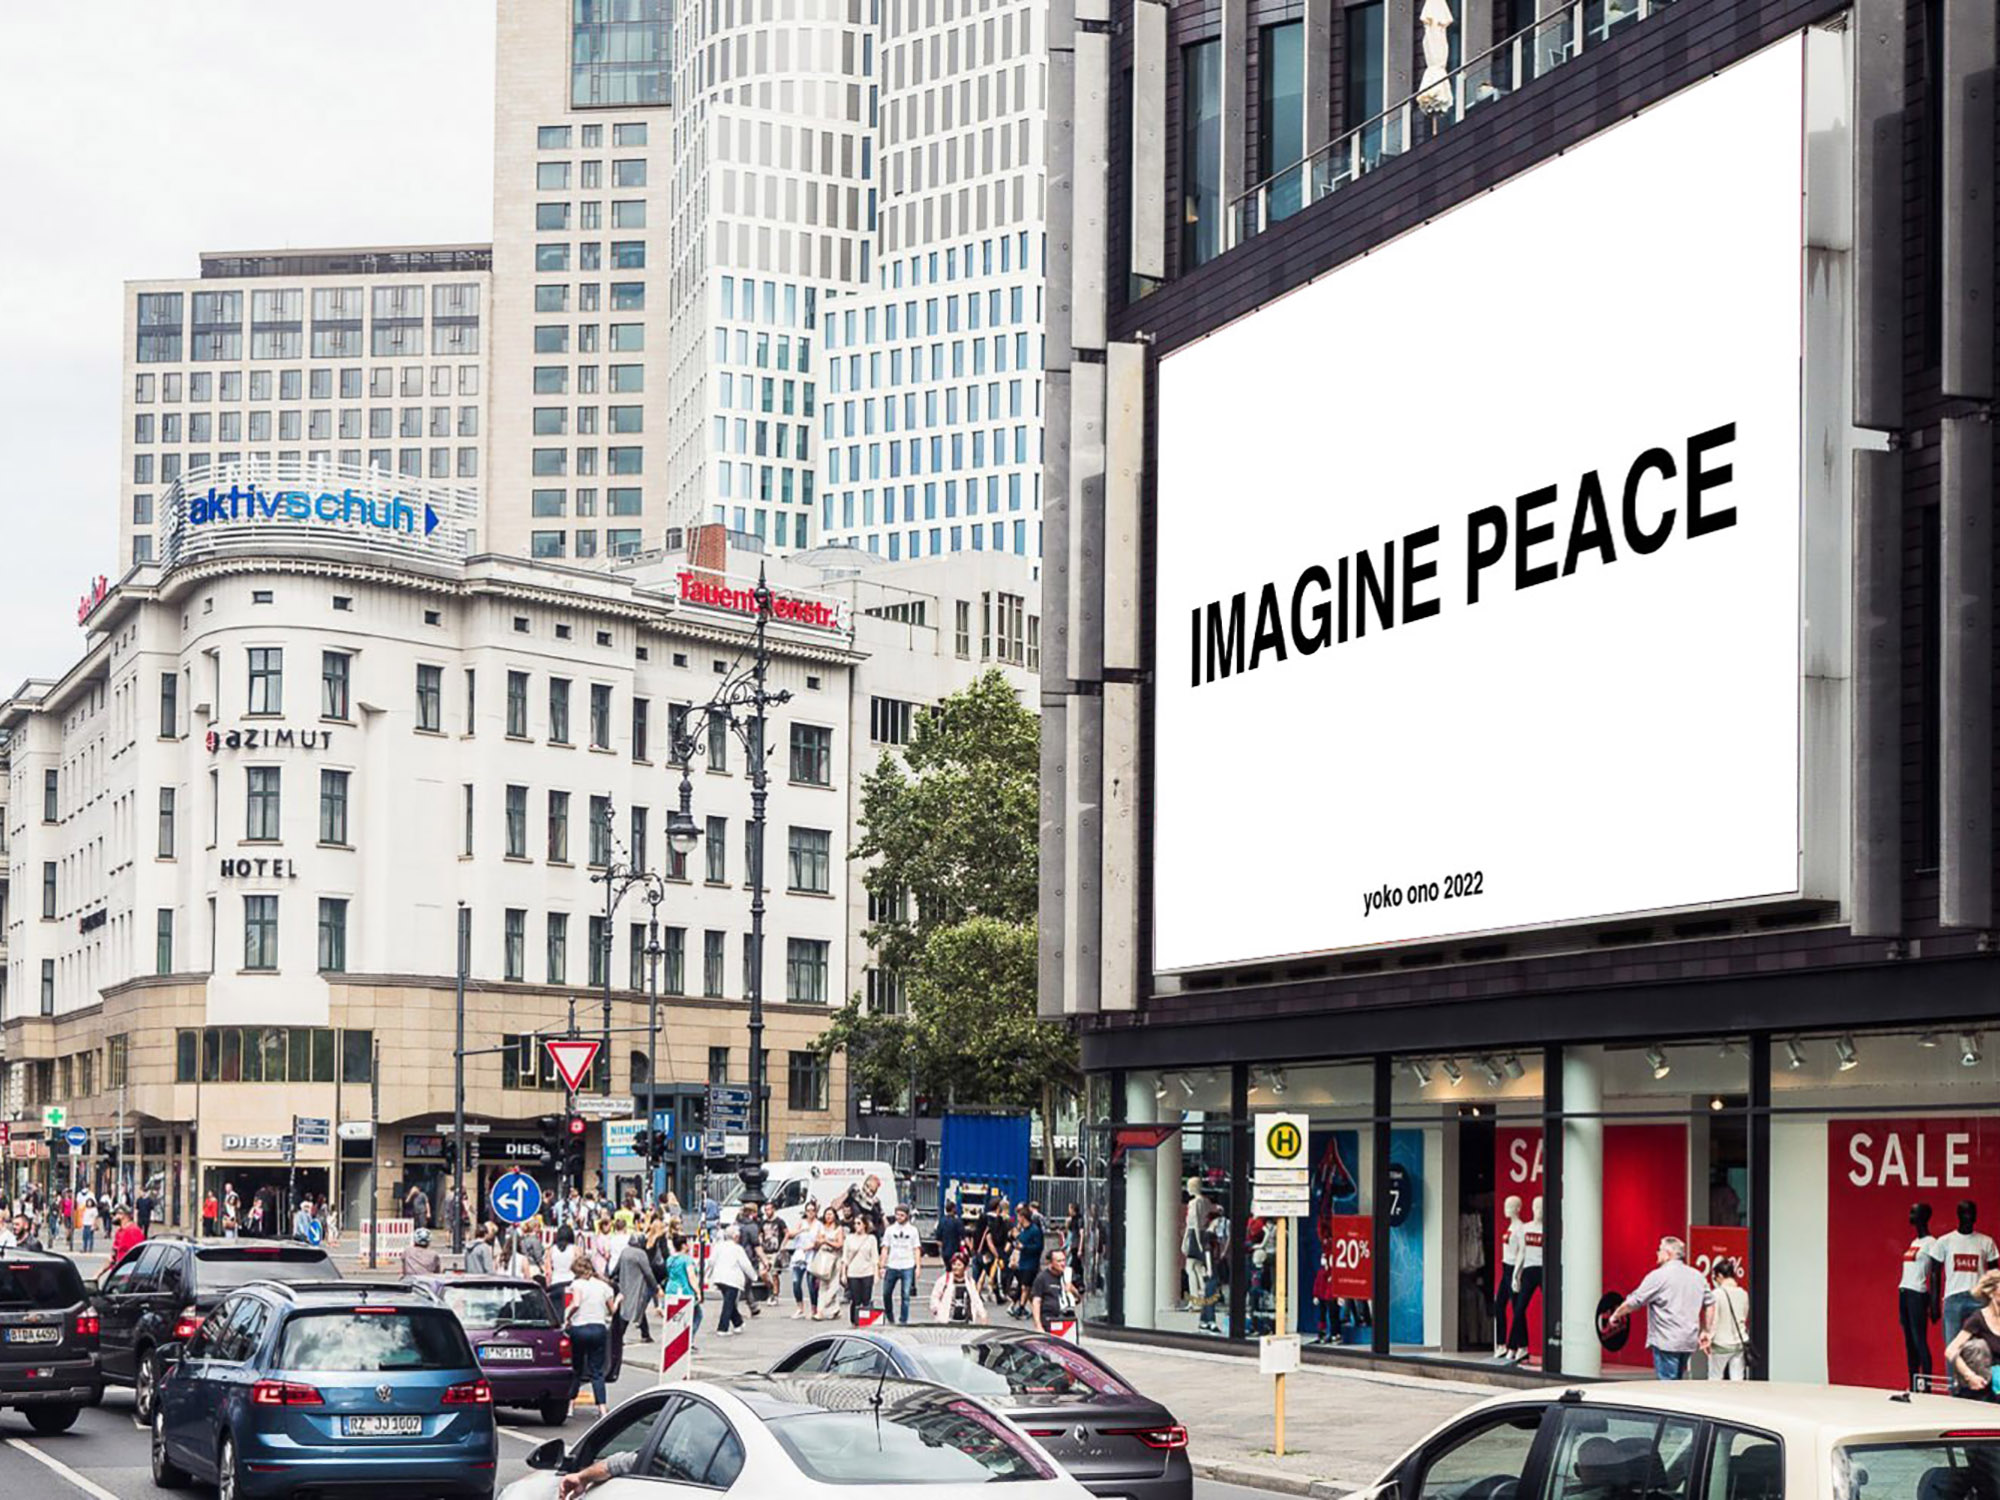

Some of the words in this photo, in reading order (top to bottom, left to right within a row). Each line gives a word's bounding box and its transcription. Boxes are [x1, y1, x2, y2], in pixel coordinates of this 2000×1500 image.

[1192, 525, 1440, 687] IMAGINE
[1467, 422, 1736, 605] PEACE
[220, 858, 298, 879] HOTEL
[1364, 885, 1402, 917] yoko
[1408, 883, 1439, 904] ono
[1445, 871, 1483, 899] 2022
[226, 1136, 284, 1150] DIESE
[685, 1136, 696, 1151] U
[1849, 1132, 1971, 1188] SALE
[1956, 1258, 1978, 1268] SALE
[350, 1417, 366, 1431] RZ
